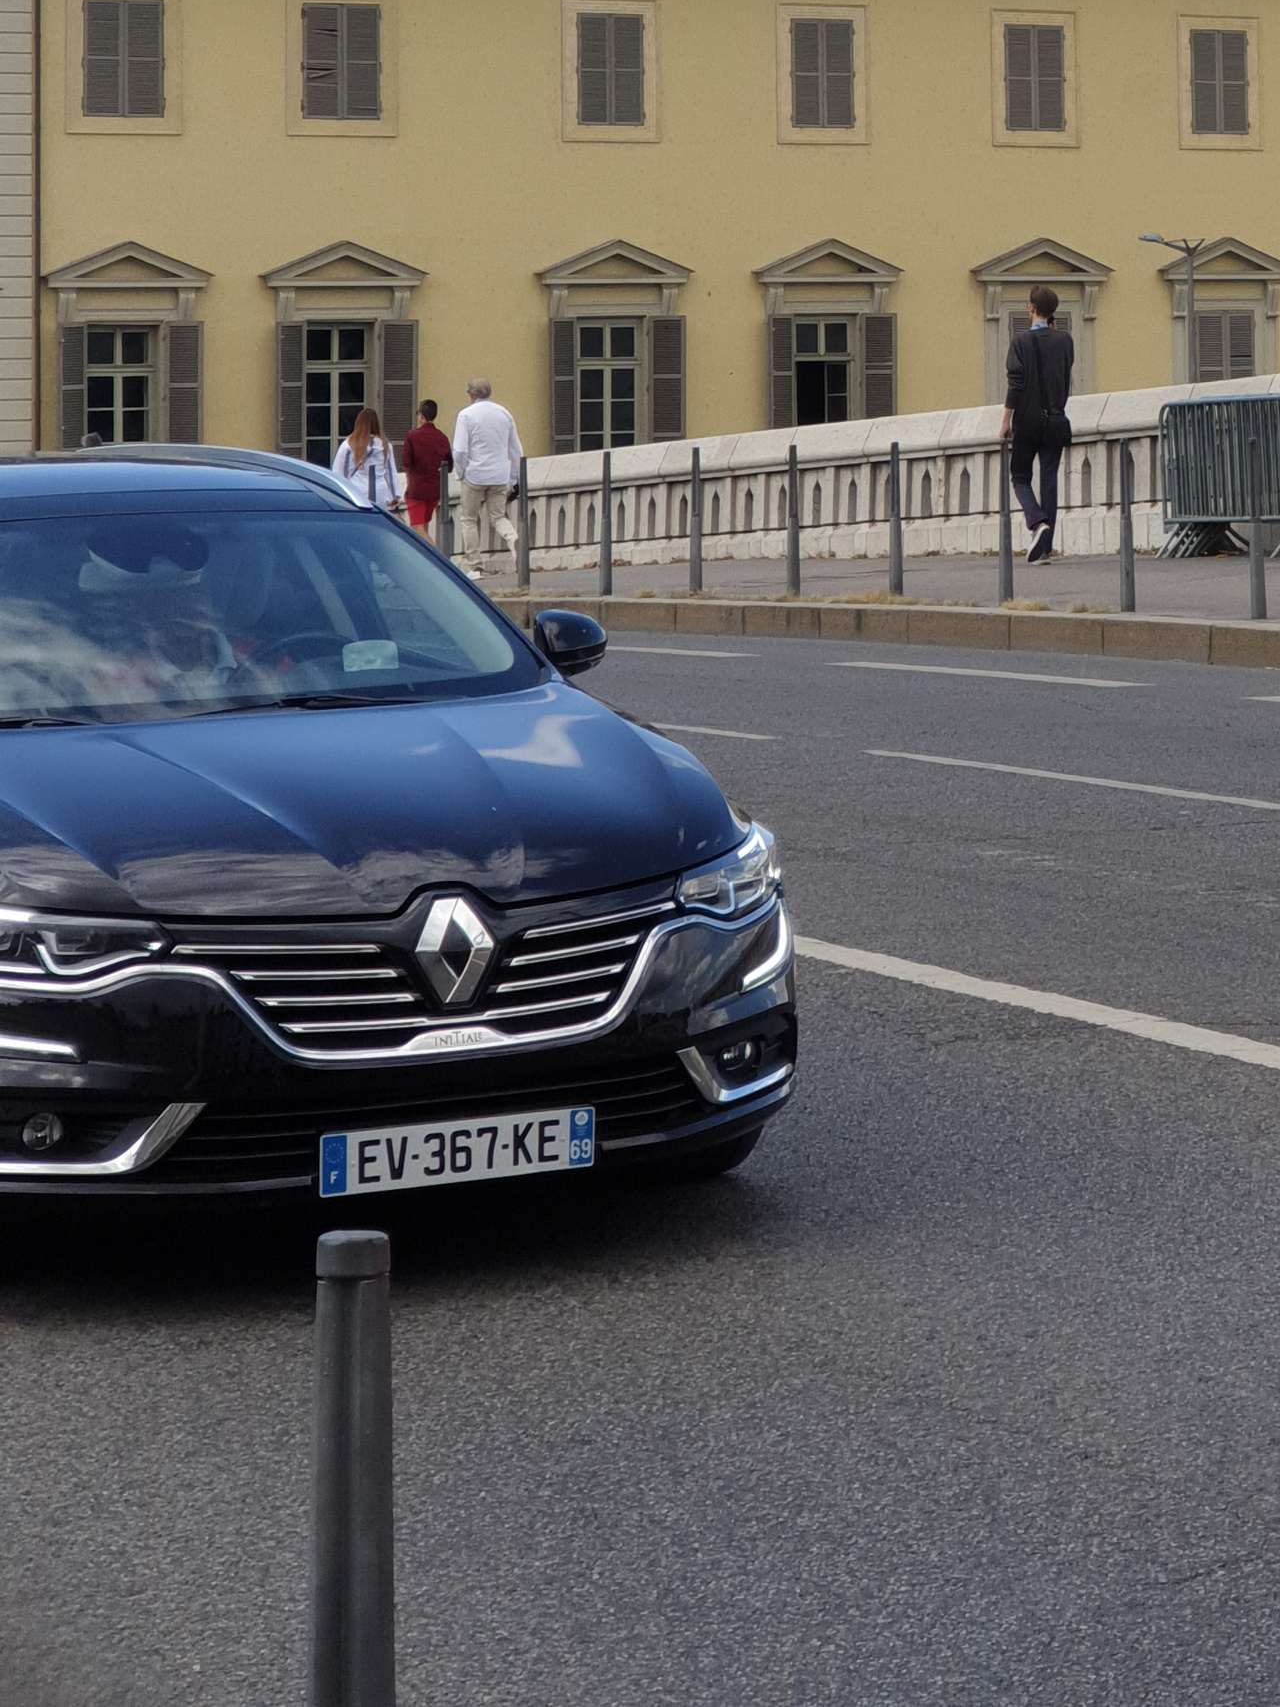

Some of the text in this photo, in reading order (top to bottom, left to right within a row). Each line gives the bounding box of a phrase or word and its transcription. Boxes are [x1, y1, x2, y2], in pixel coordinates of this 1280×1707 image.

[357, 1119, 560, 1185] EV-367-KE
[570, 1138, 592, 1160] 69
[329, 1170, 339, 1185] F
